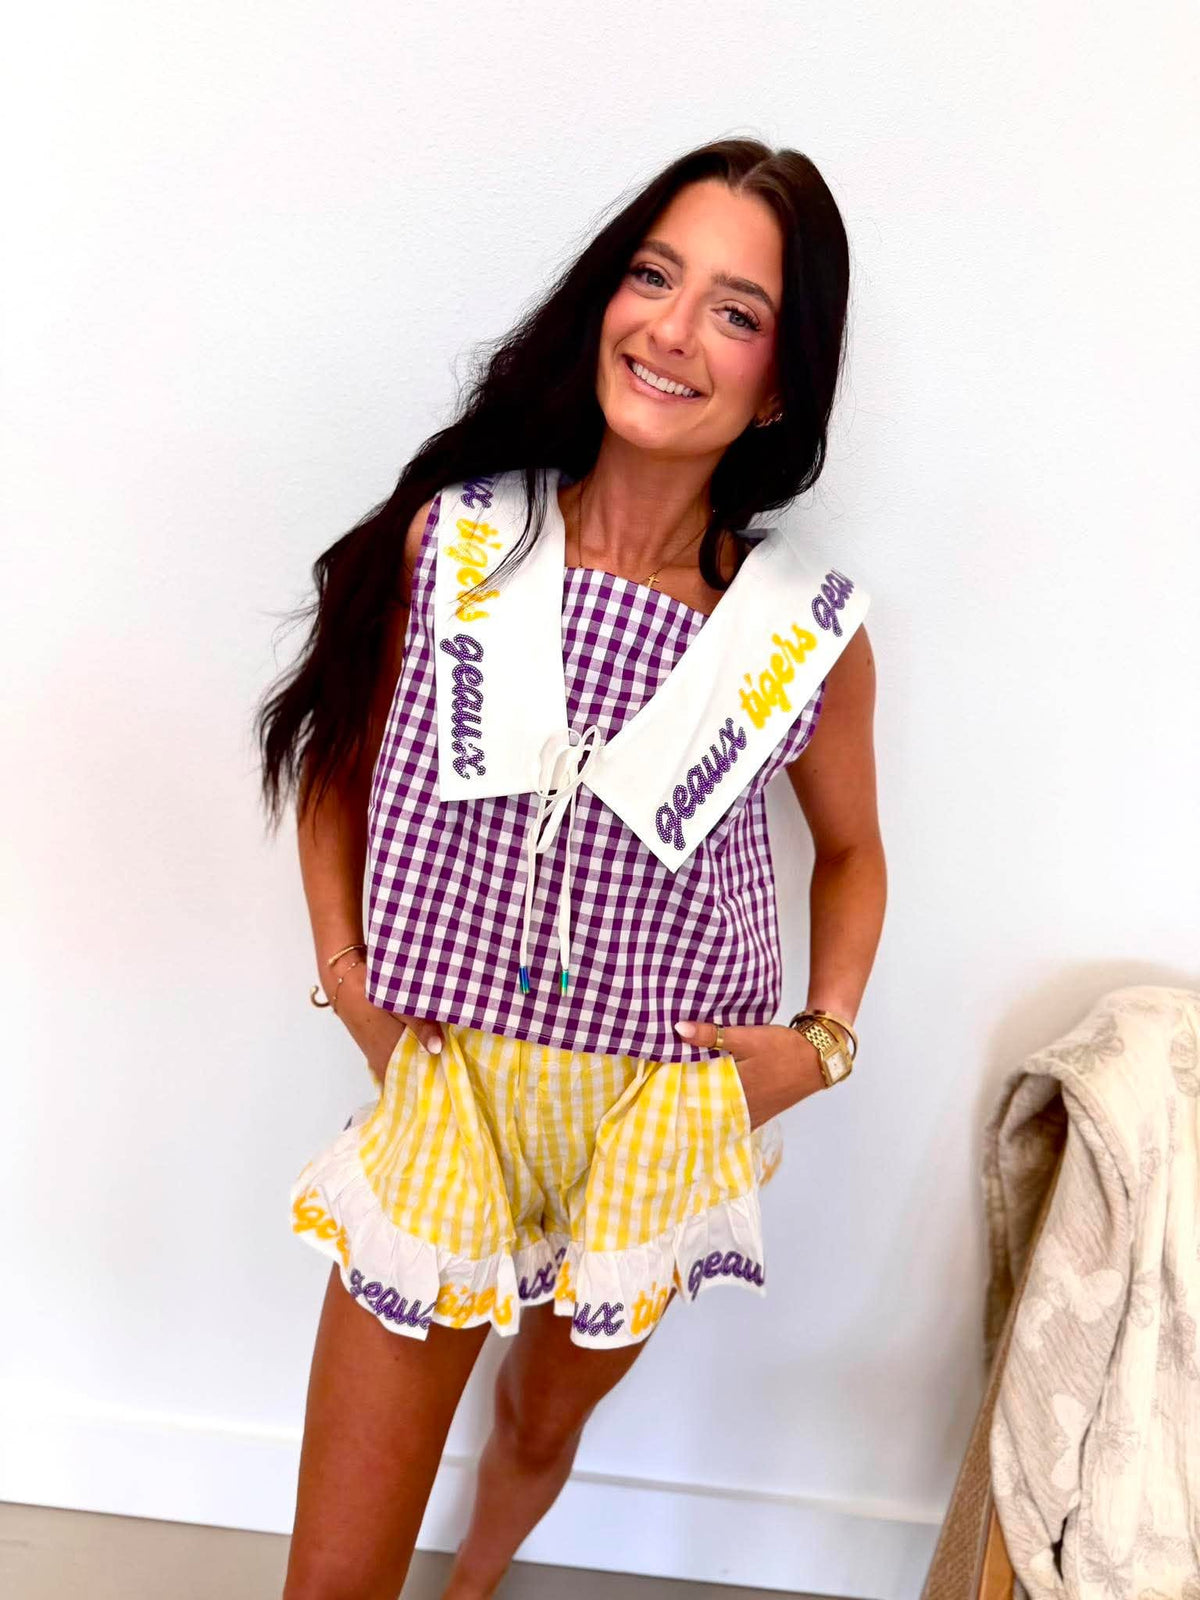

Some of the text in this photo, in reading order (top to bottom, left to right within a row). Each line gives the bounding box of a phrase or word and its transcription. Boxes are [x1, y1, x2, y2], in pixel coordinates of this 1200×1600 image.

[439, 633, 486, 780] geaux
[655, 717, 747, 851] geaux
[738, 621, 818, 730] tigers
[687, 1250, 765, 1302] geau
